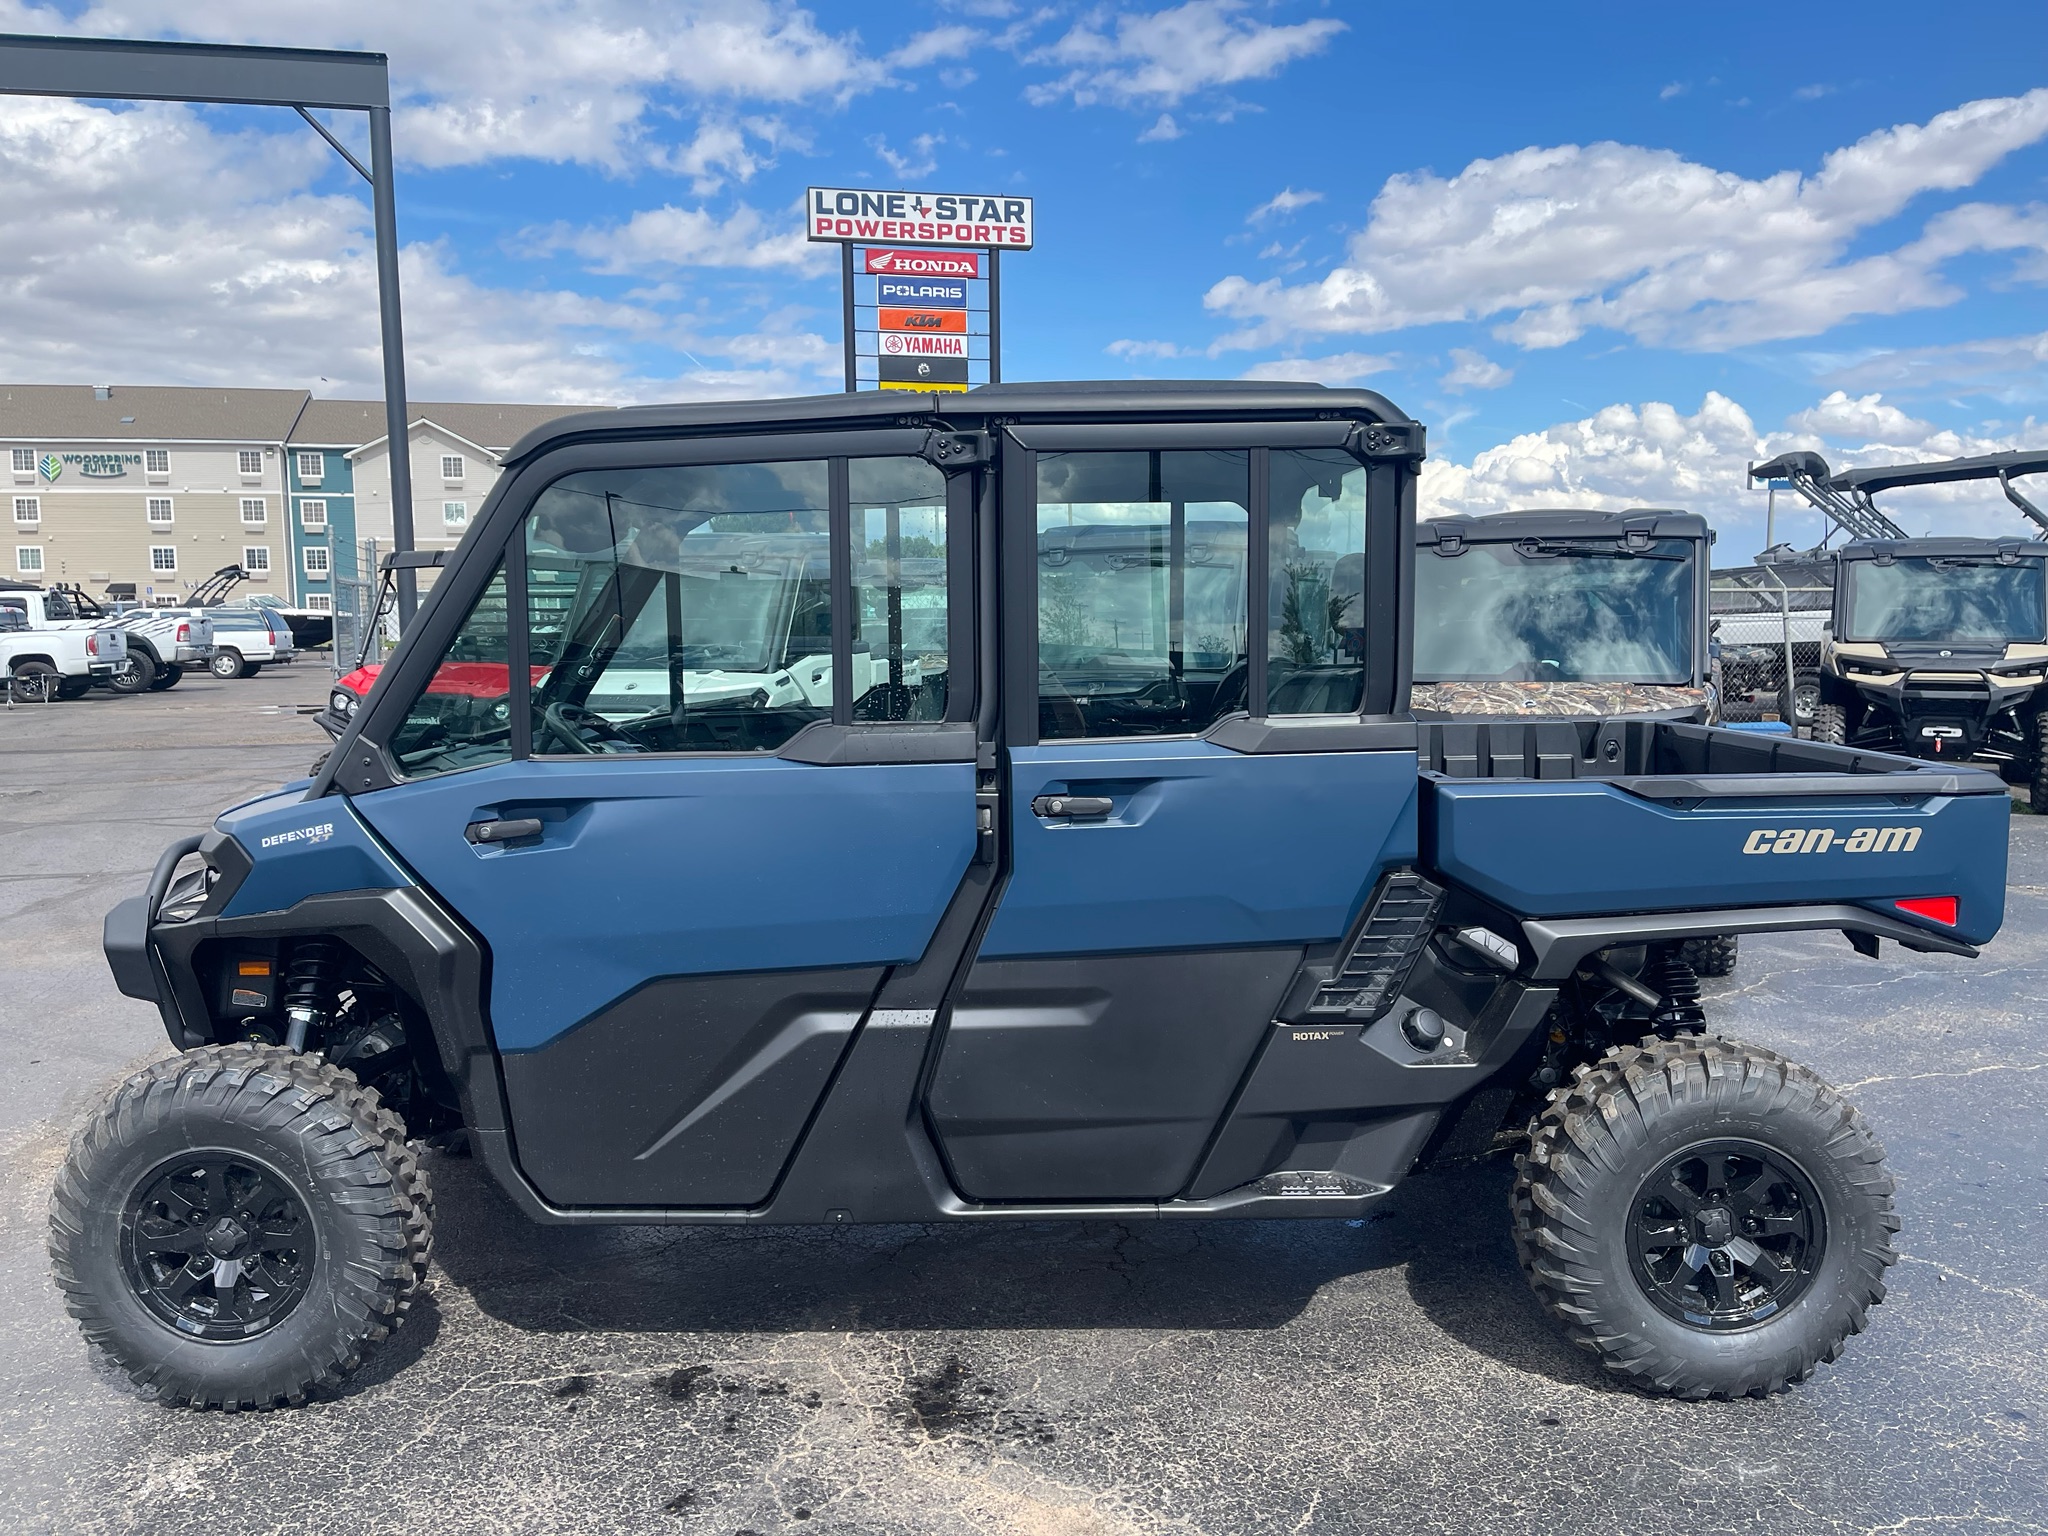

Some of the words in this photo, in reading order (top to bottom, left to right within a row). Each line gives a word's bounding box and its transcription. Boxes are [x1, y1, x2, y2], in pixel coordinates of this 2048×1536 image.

[815, 191, 906, 219] LONE
[935, 197, 1026, 224] STAR
[816, 217, 1026, 243] POWERSPORTS
[893, 258, 975, 273] HONDA
[883, 284, 963, 299] POLARIS
[904, 313, 942, 327] KTM
[904, 336, 963, 355] YAMAHA
[62, 454, 141, 465] WOODSPRING
[83, 463, 123, 473] SUITES
[406, 716, 441, 725] wasaki
[261, 823, 334, 848] DEFENDER
[306, 833, 334, 846] XT
[1742, 826, 1923, 855] can-am
[1292, 1031, 1330, 1041] ROTAX
